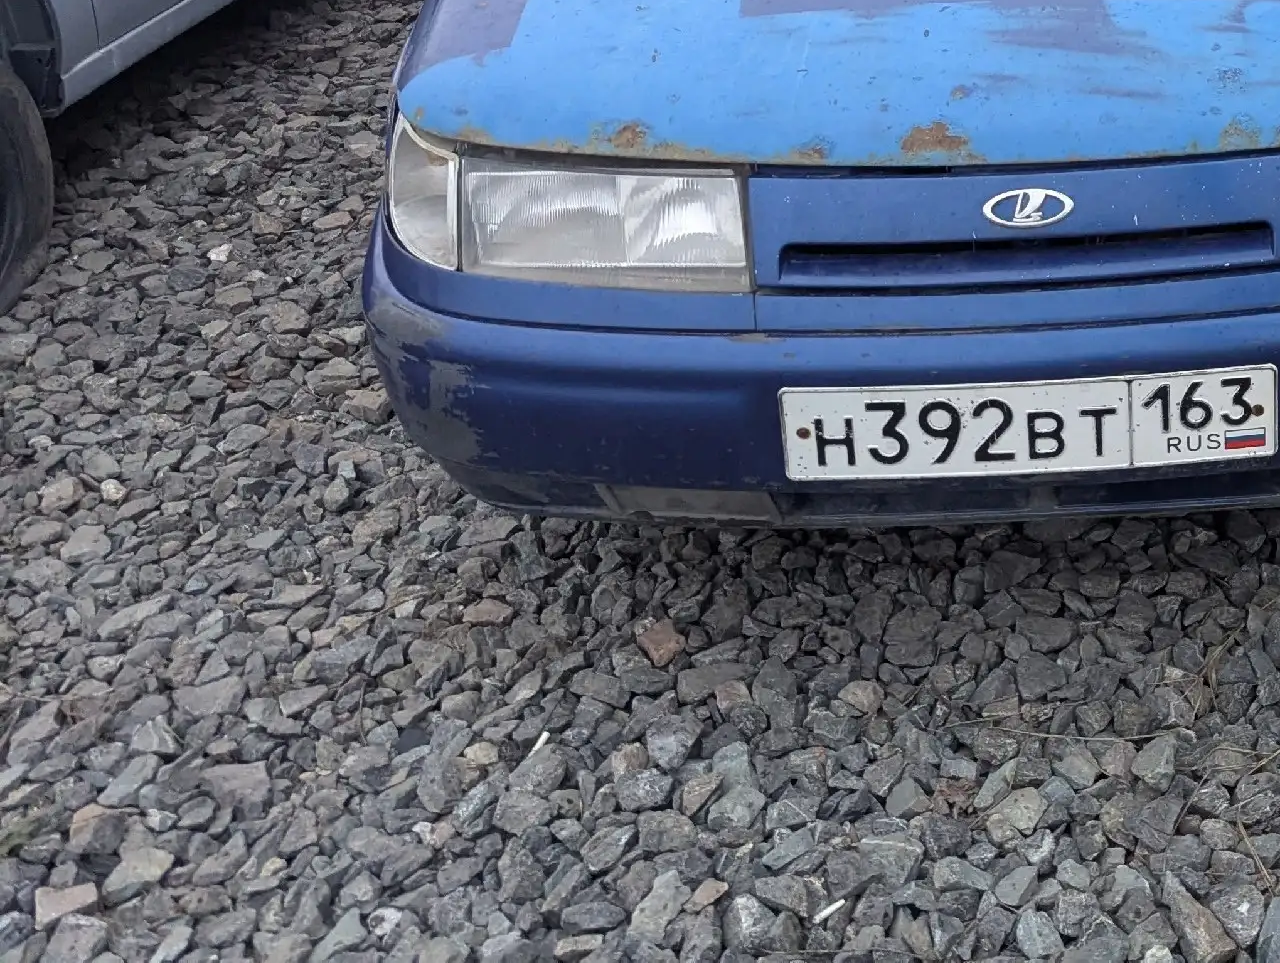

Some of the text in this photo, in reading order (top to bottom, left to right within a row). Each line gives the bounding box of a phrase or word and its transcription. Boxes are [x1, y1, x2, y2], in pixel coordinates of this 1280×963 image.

[814, 376, 1254, 467] Н392ВТ 163
[1166, 433, 1222, 454] RUS
